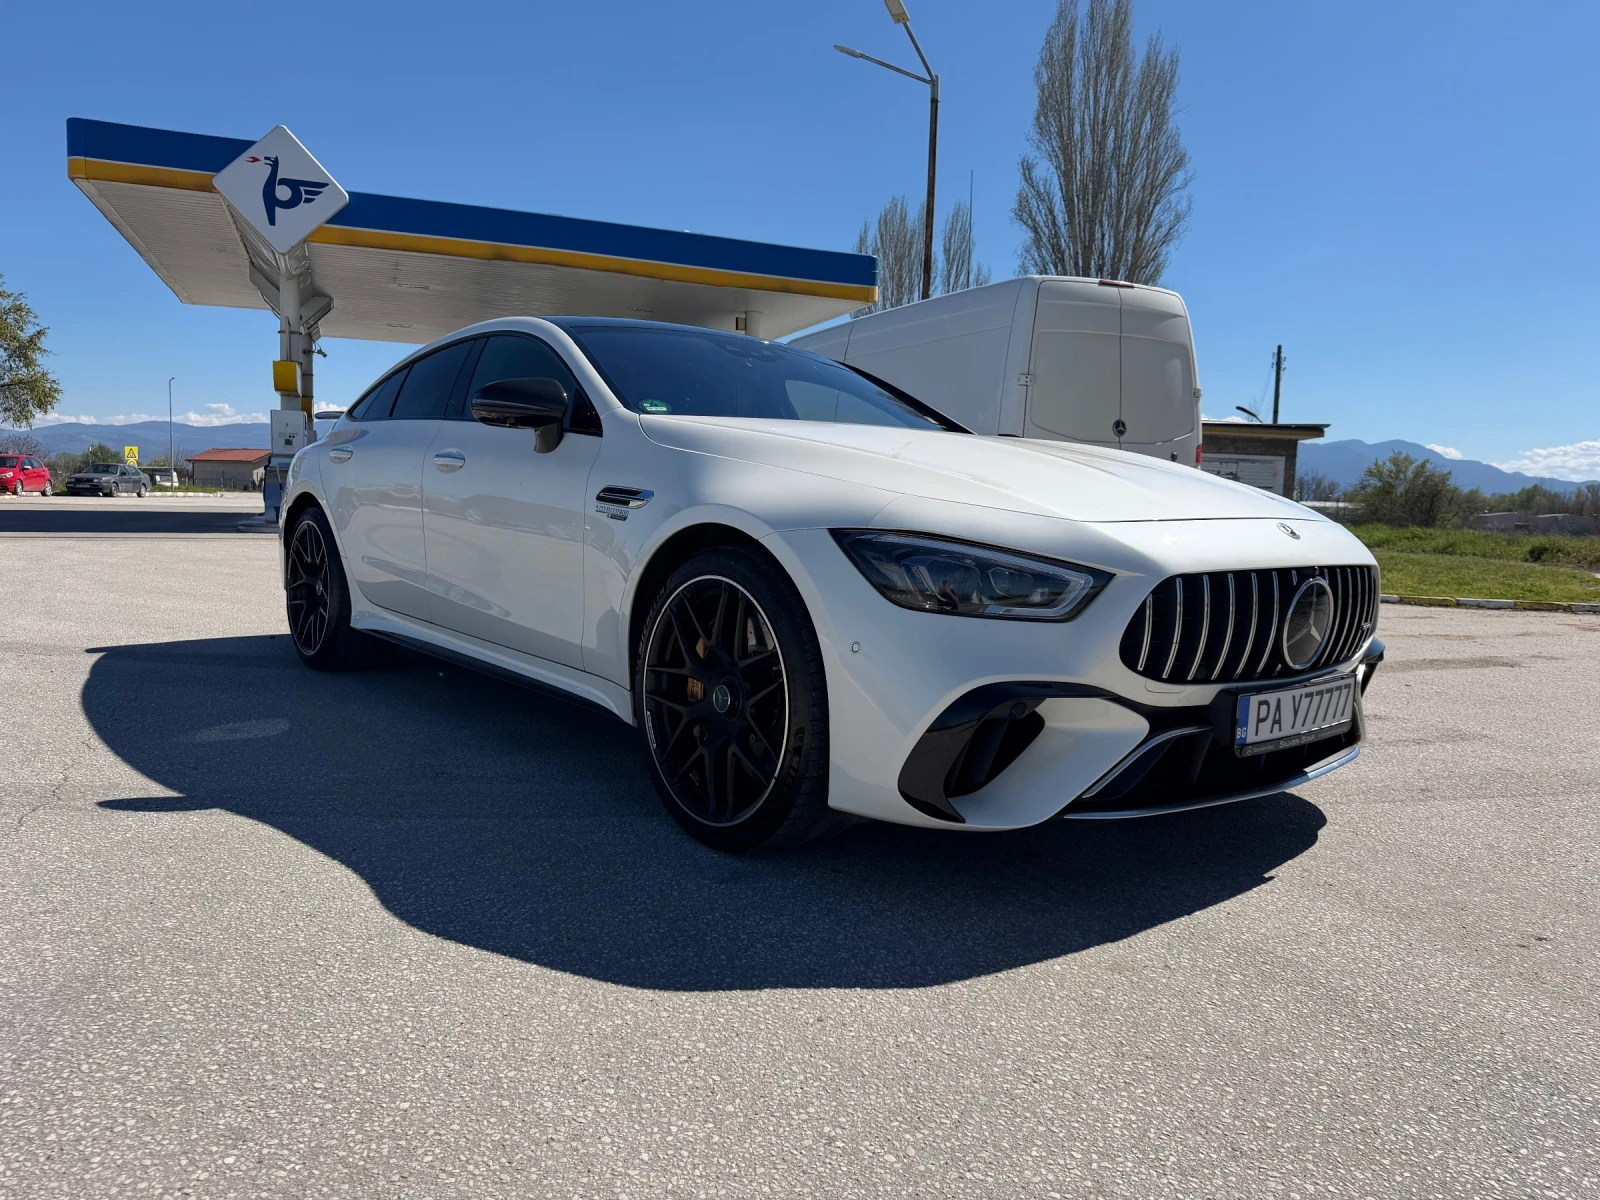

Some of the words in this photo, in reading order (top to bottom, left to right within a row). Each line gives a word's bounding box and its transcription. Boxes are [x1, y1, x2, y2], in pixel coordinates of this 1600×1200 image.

[1255, 698, 1282, 736] PA
[1291, 683, 1352, 729] Y77777
[1236, 727, 1247, 739] BG
[1279, 738, 1300, 748] SILVER
[1301, 735, 1315, 743] STAR
